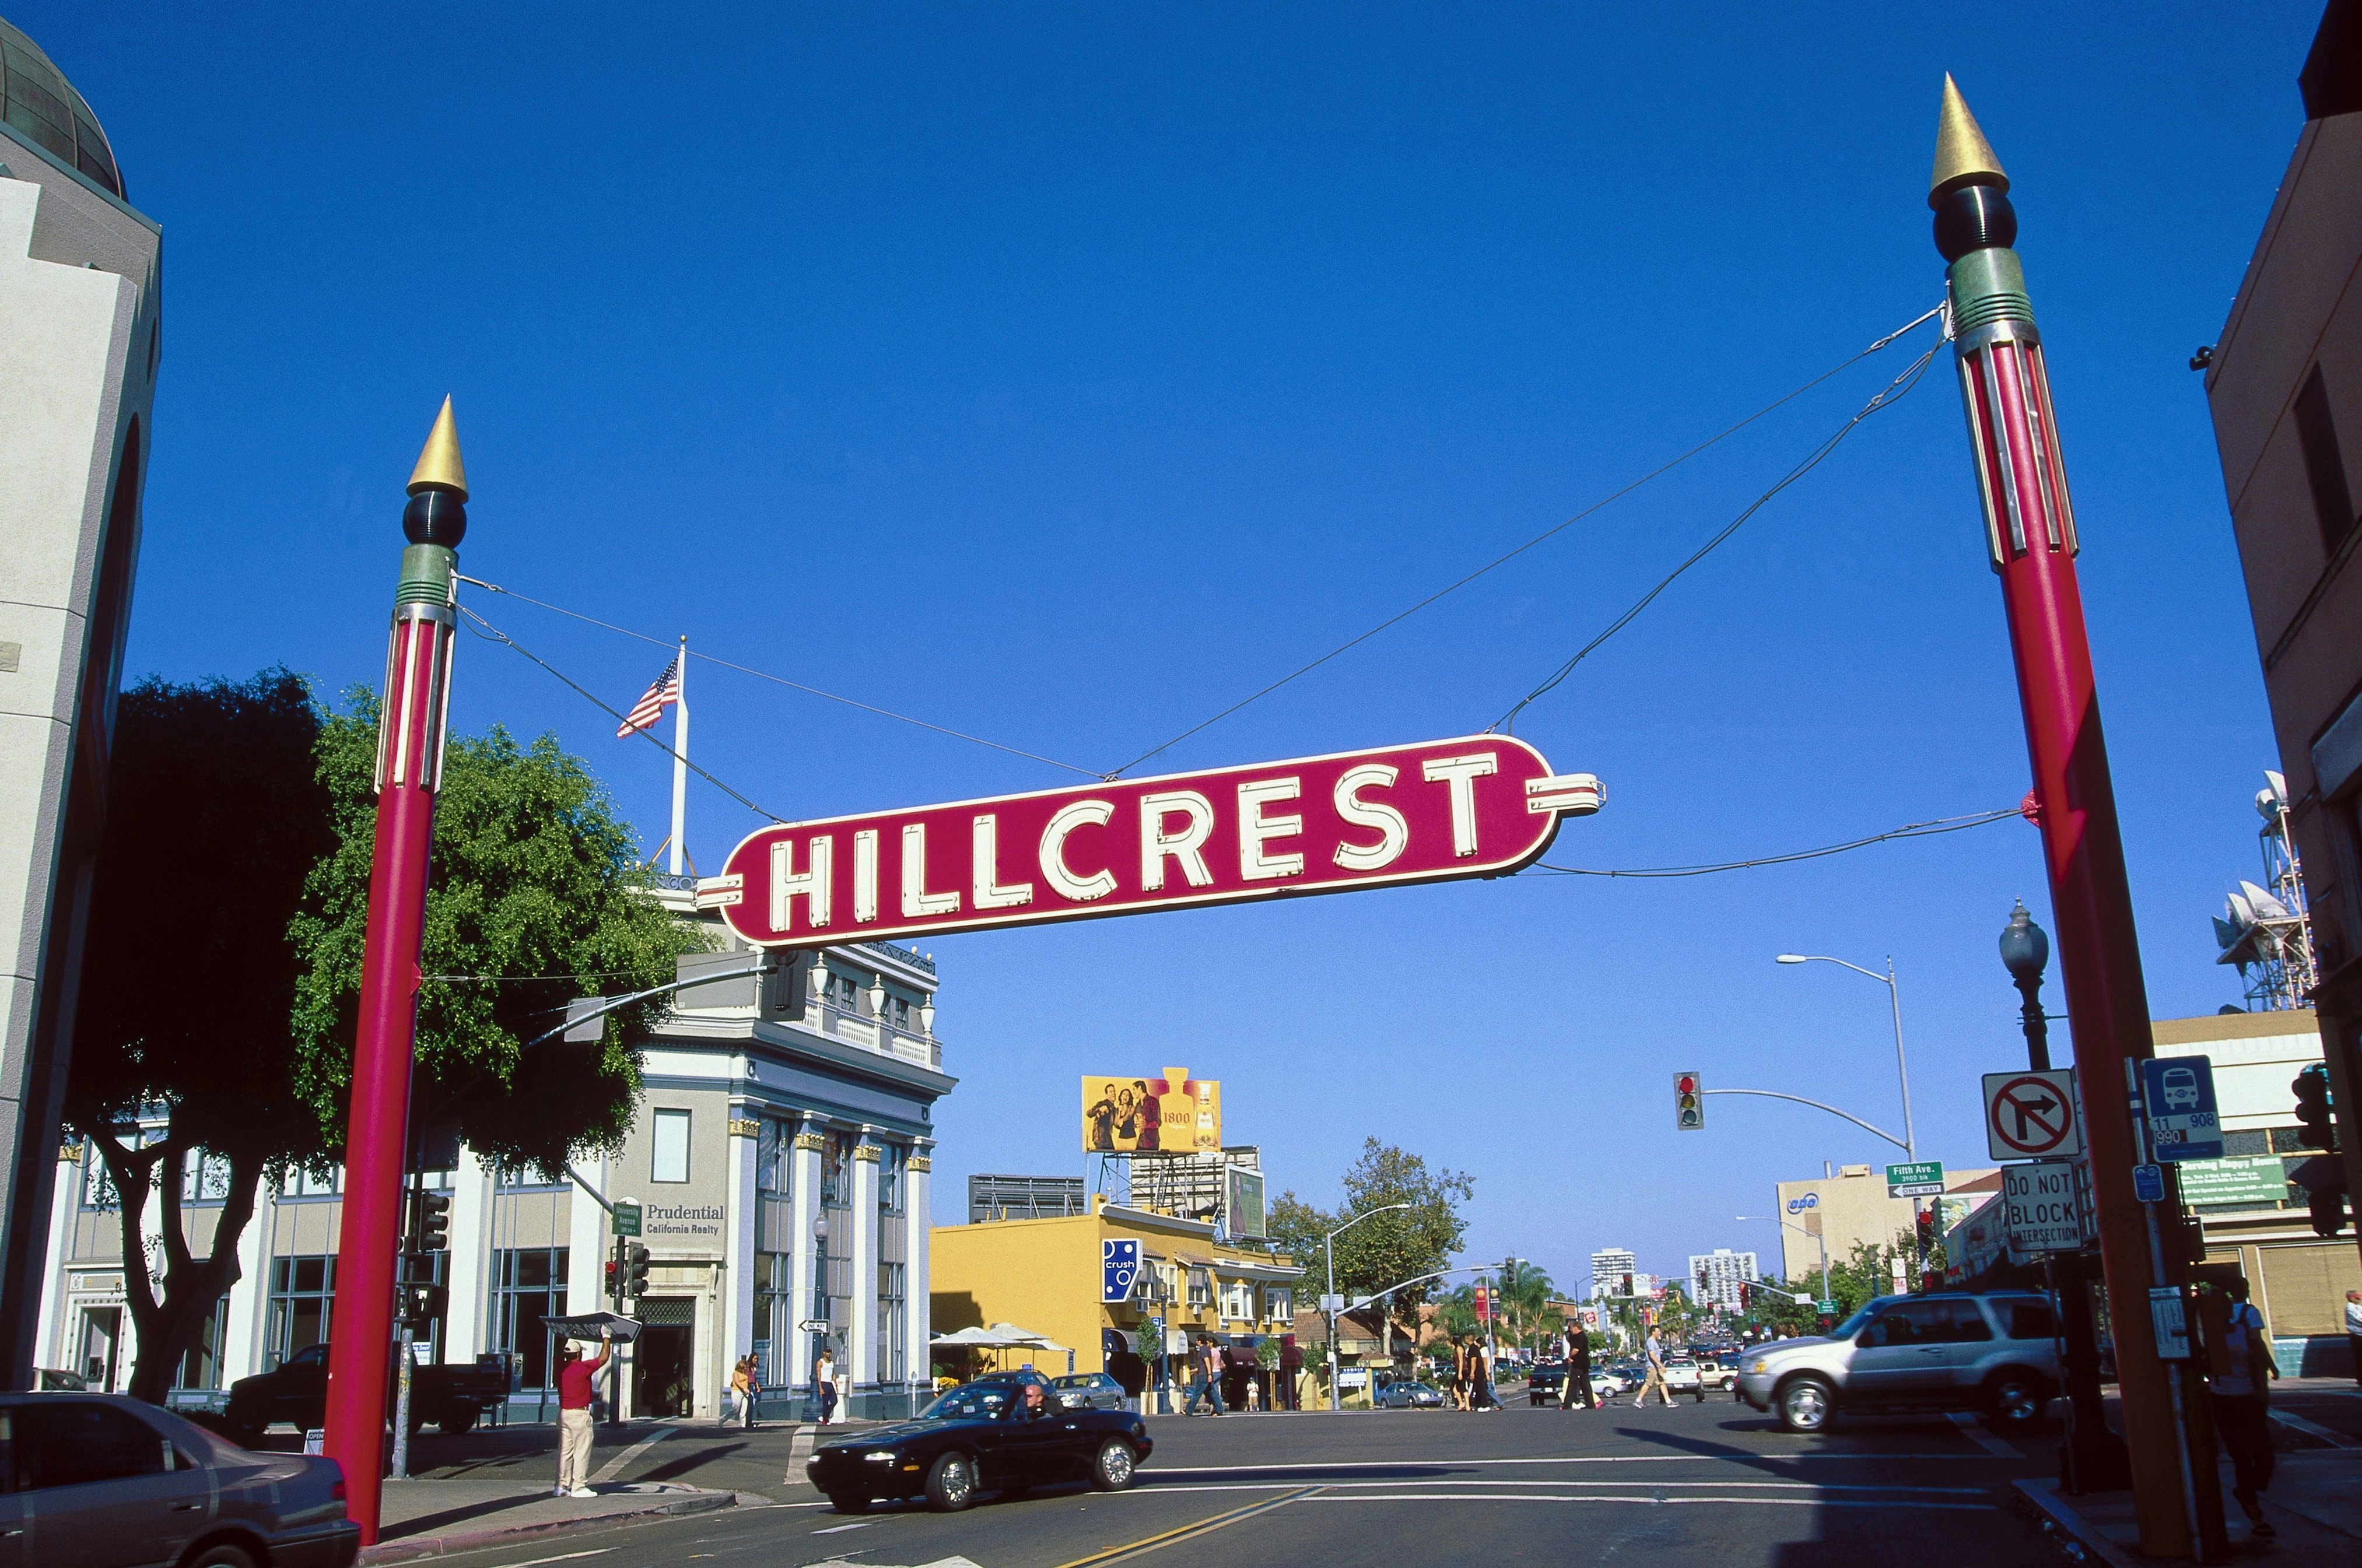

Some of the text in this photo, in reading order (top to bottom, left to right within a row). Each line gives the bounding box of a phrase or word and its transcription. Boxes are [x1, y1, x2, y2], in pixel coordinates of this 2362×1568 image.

[770, 752, 1498, 932] HILLCREST
[1164, 1112, 1190, 1124] 1800
[2154, 1113, 2215, 1130] 11 908
[2156, 1130, 2181, 1143] 990
[1893, 1165, 1935, 1176] Fifth Ave.
[2008, 1173, 2070, 1196] DO NOT
[616, 1206, 639, 1218] University
[647, 1204, 724, 1220] Prudential
[2010, 1202, 2076, 1225] BLOCK
[618, 1217, 636, 1226] Avenue
[647, 1224, 719, 1236] California Realty
[2013, 1226, 2079, 1243] INTERSECTION
[1106, 1260, 1135, 1268] crush
